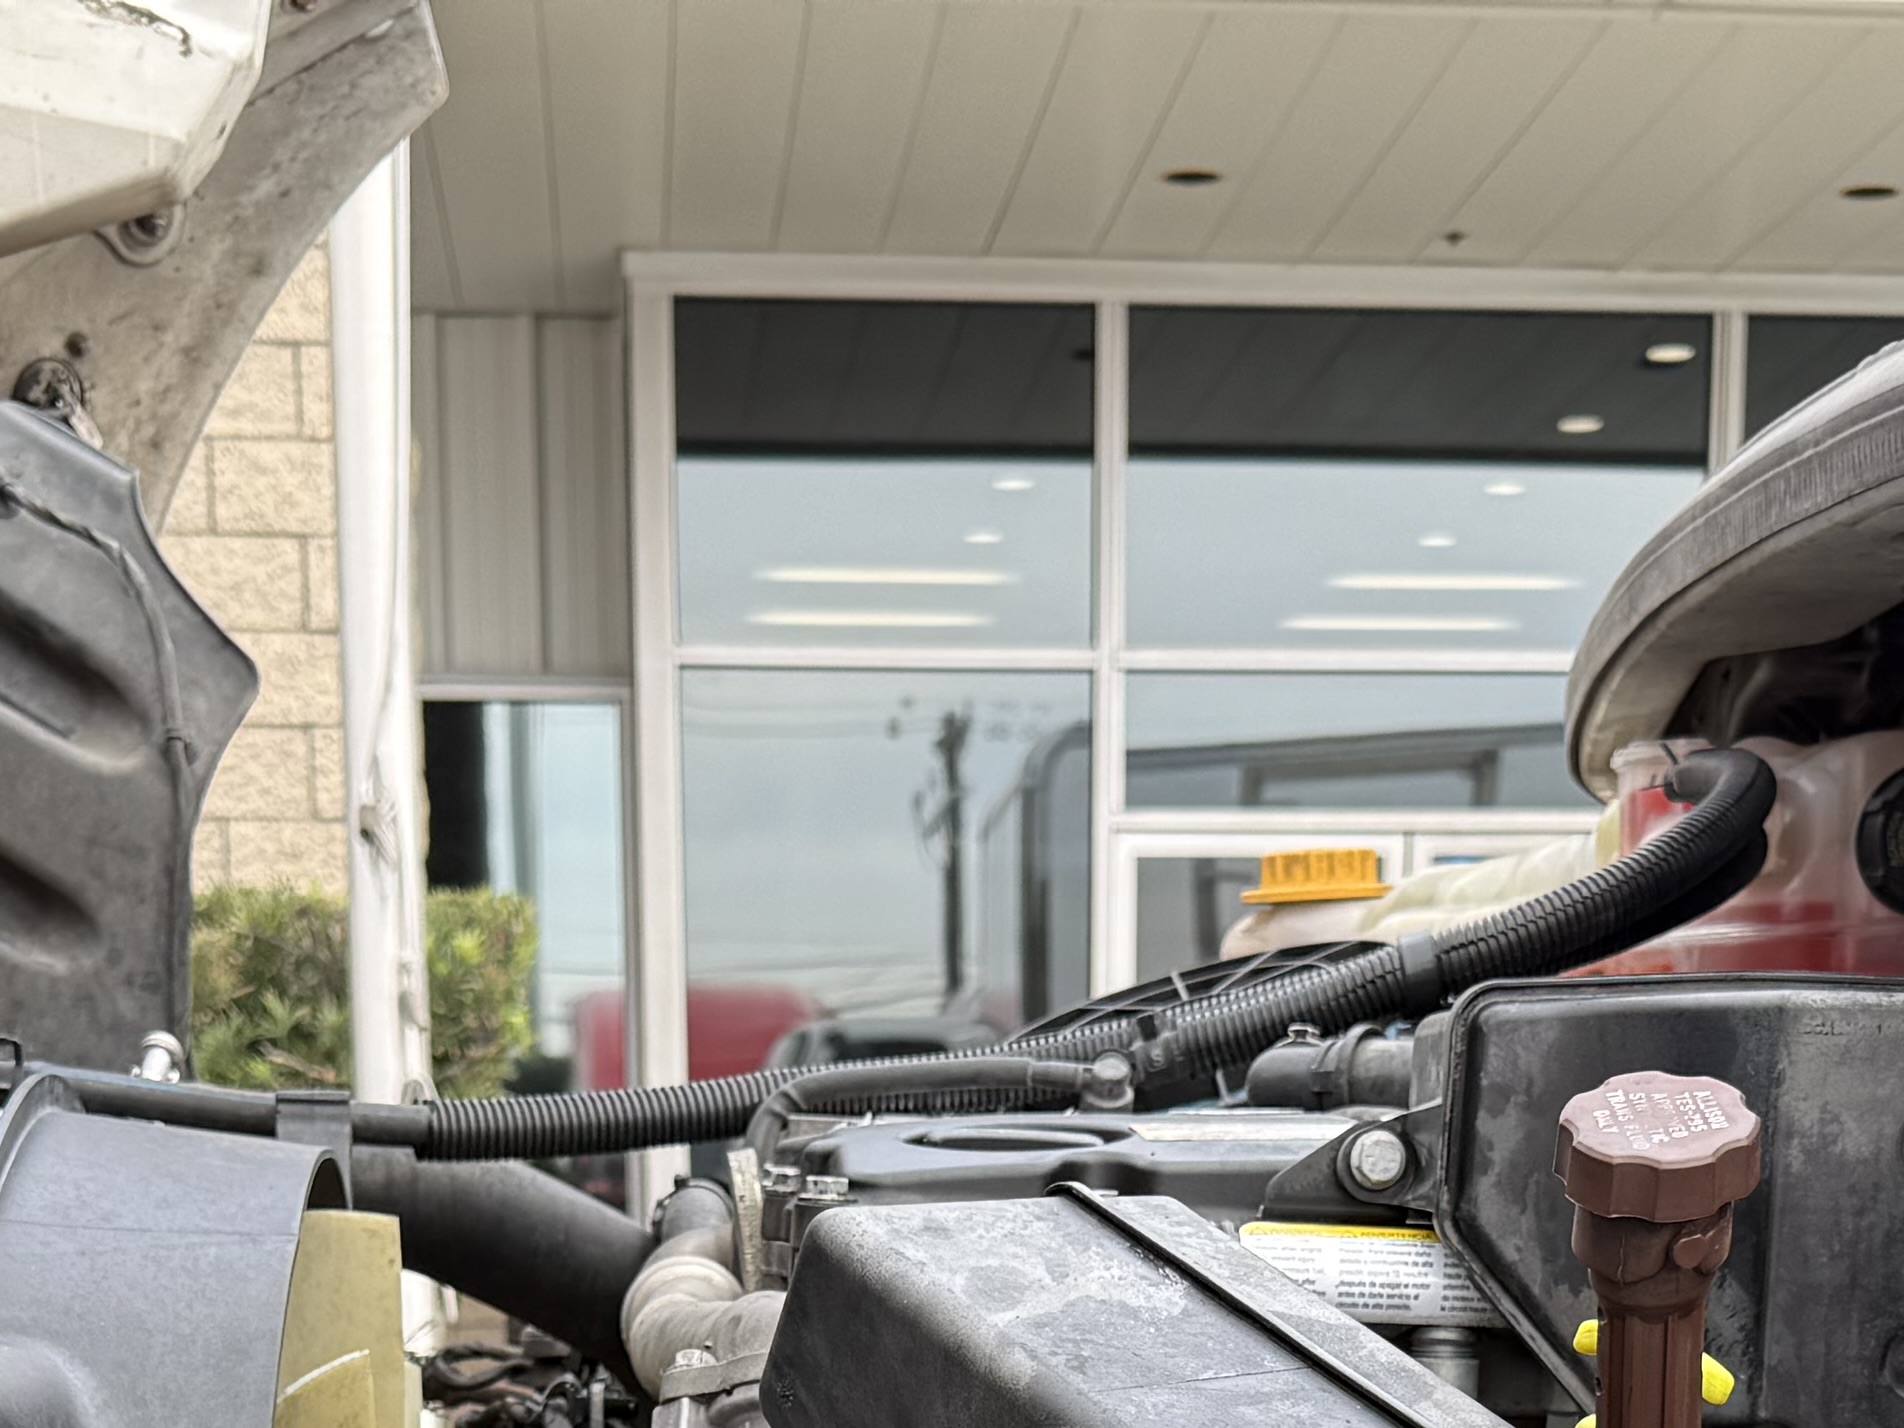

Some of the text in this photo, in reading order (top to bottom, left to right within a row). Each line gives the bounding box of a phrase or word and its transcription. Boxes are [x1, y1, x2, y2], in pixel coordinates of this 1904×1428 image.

[1592, 1109, 1619, 1134] ONLY
[1605, 1089, 1650, 1150] TRANS FLUID
[1673, 1092, 1708, 1132] TES-295
[1693, 1090, 1729, 1130] ALLISON
